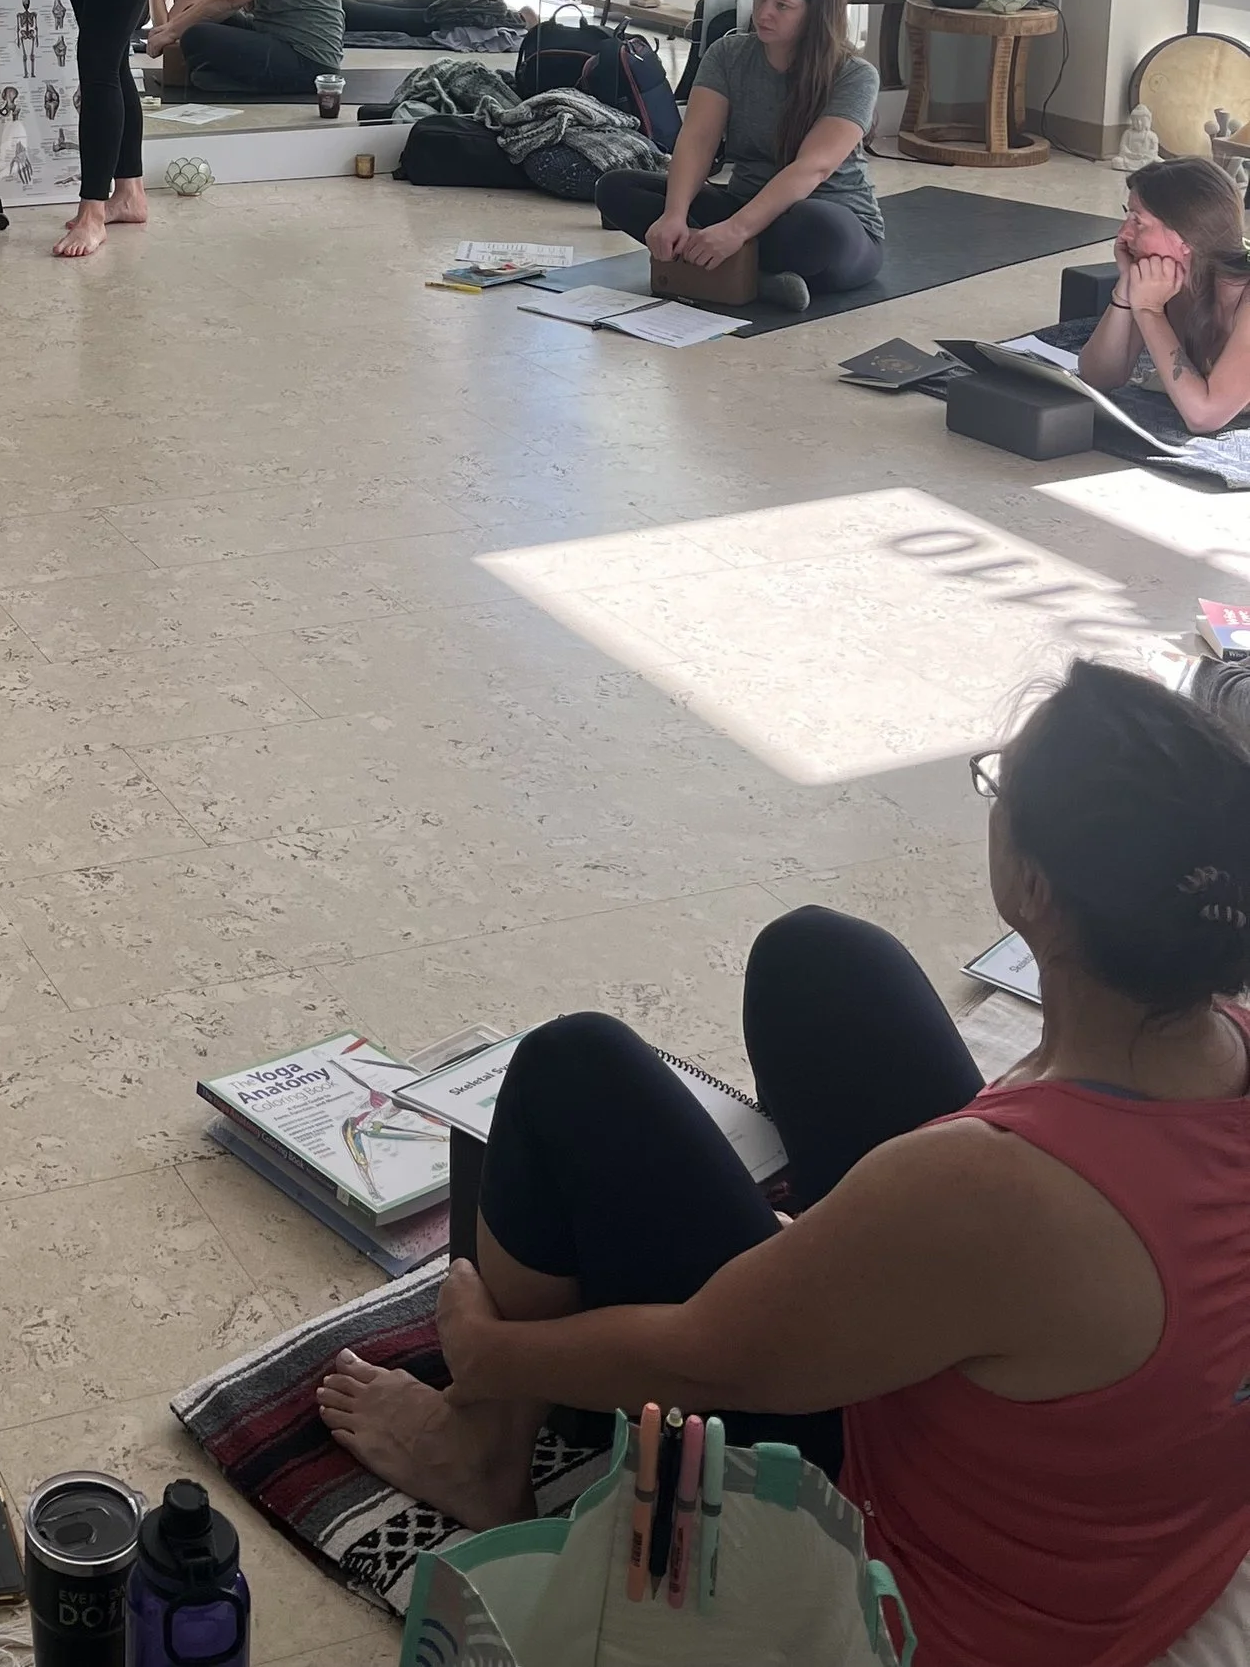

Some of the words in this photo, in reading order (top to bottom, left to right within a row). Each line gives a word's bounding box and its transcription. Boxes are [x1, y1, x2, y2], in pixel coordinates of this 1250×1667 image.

[228, 1077, 257, 1091] The
[248, 1062, 304, 1085] Yoga
[237, 1066, 332, 1105] Anatomy
[449, 1071, 495, 1096] Skeletal
[251, 1088, 308, 1114] Coloring
[306, 1079, 340, 1096] Book
